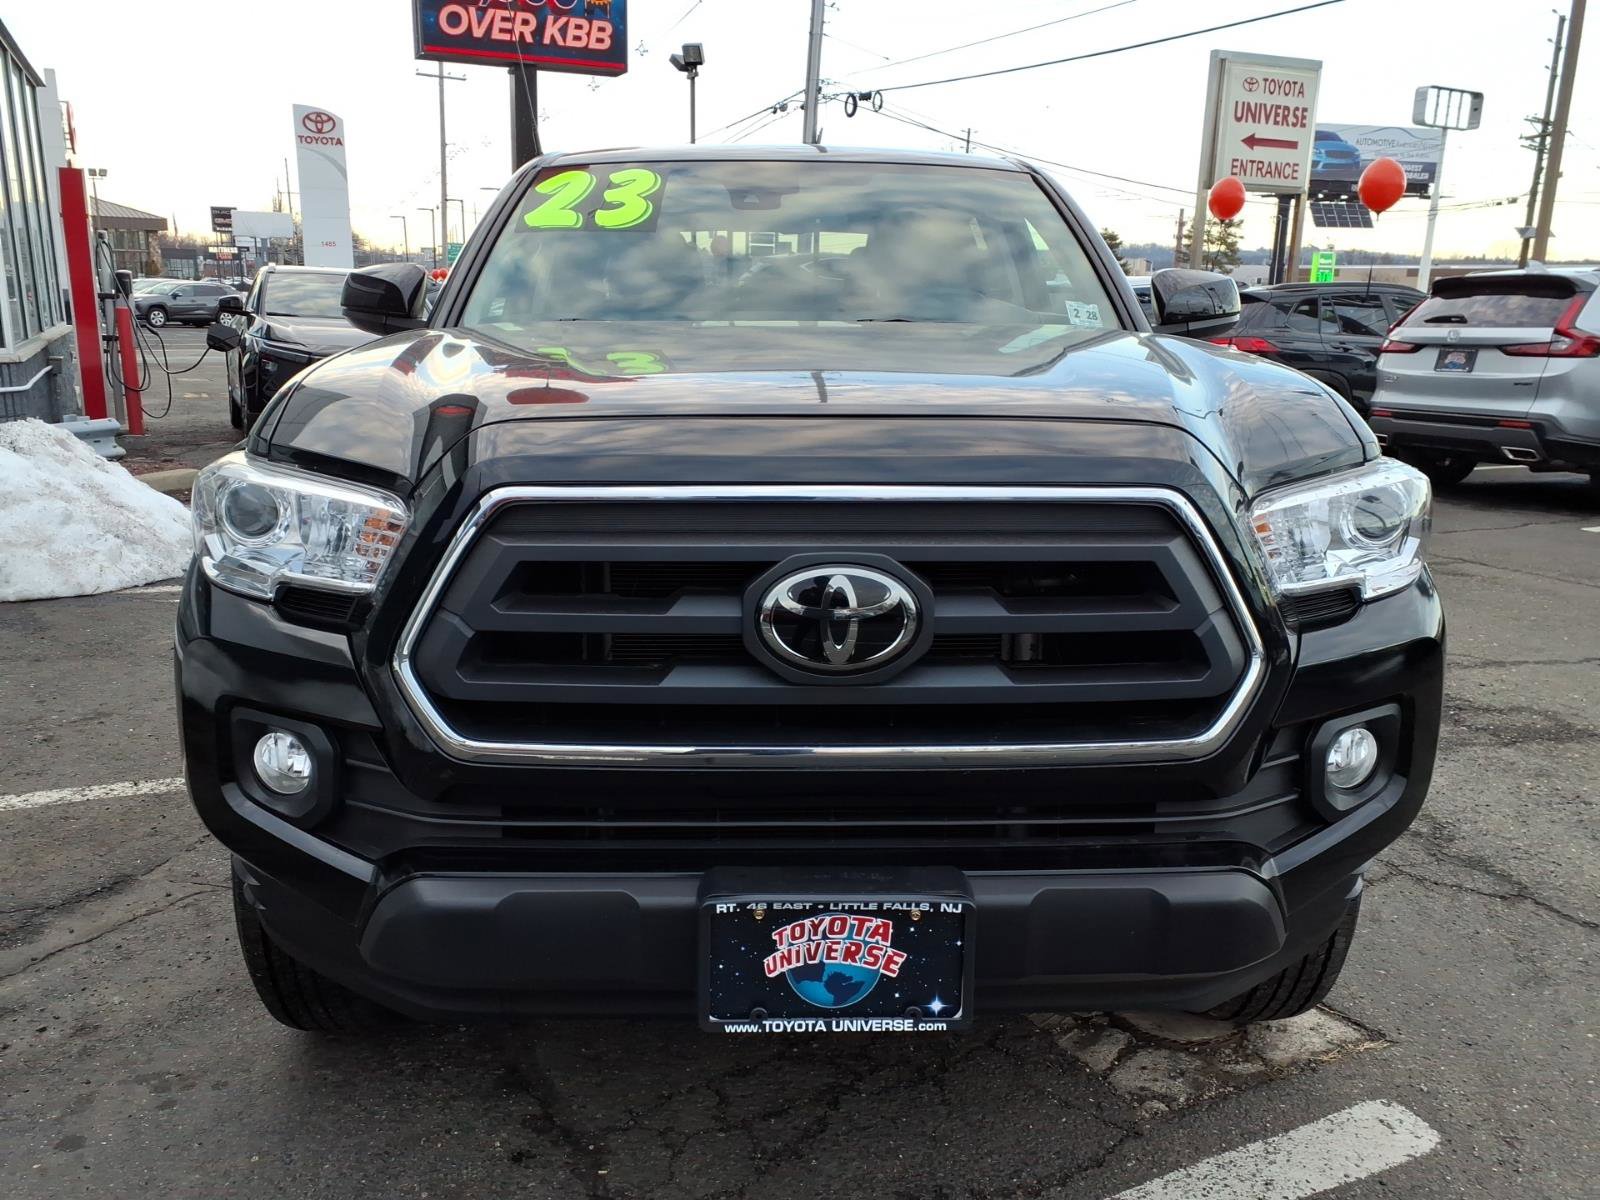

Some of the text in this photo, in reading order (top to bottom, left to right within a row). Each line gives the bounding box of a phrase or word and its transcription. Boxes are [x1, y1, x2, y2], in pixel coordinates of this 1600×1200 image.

[438, 5, 613, 50] OVER KBB
[1262, 77, 1305, 98] TOYOTA
[1234, 100, 1308, 128] UNIVERSE
[298, 135, 343, 146] TOYOTA
[1230, 158, 1300, 180] ENTRANCE
[524, 168, 662, 229] 23
[716, 903, 740, 914] RT.
[773, 902, 812, 910] EAST
[883, 902, 934, 912] FALLS,
[940, 903, 963, 913] NJ
[772, 915, 893, 950] TOYOTA
[763, 938, 907, 977] UNIVERSE
[725, 1019, 947, 1033] www.TOYOTA UNIVERSE.com
